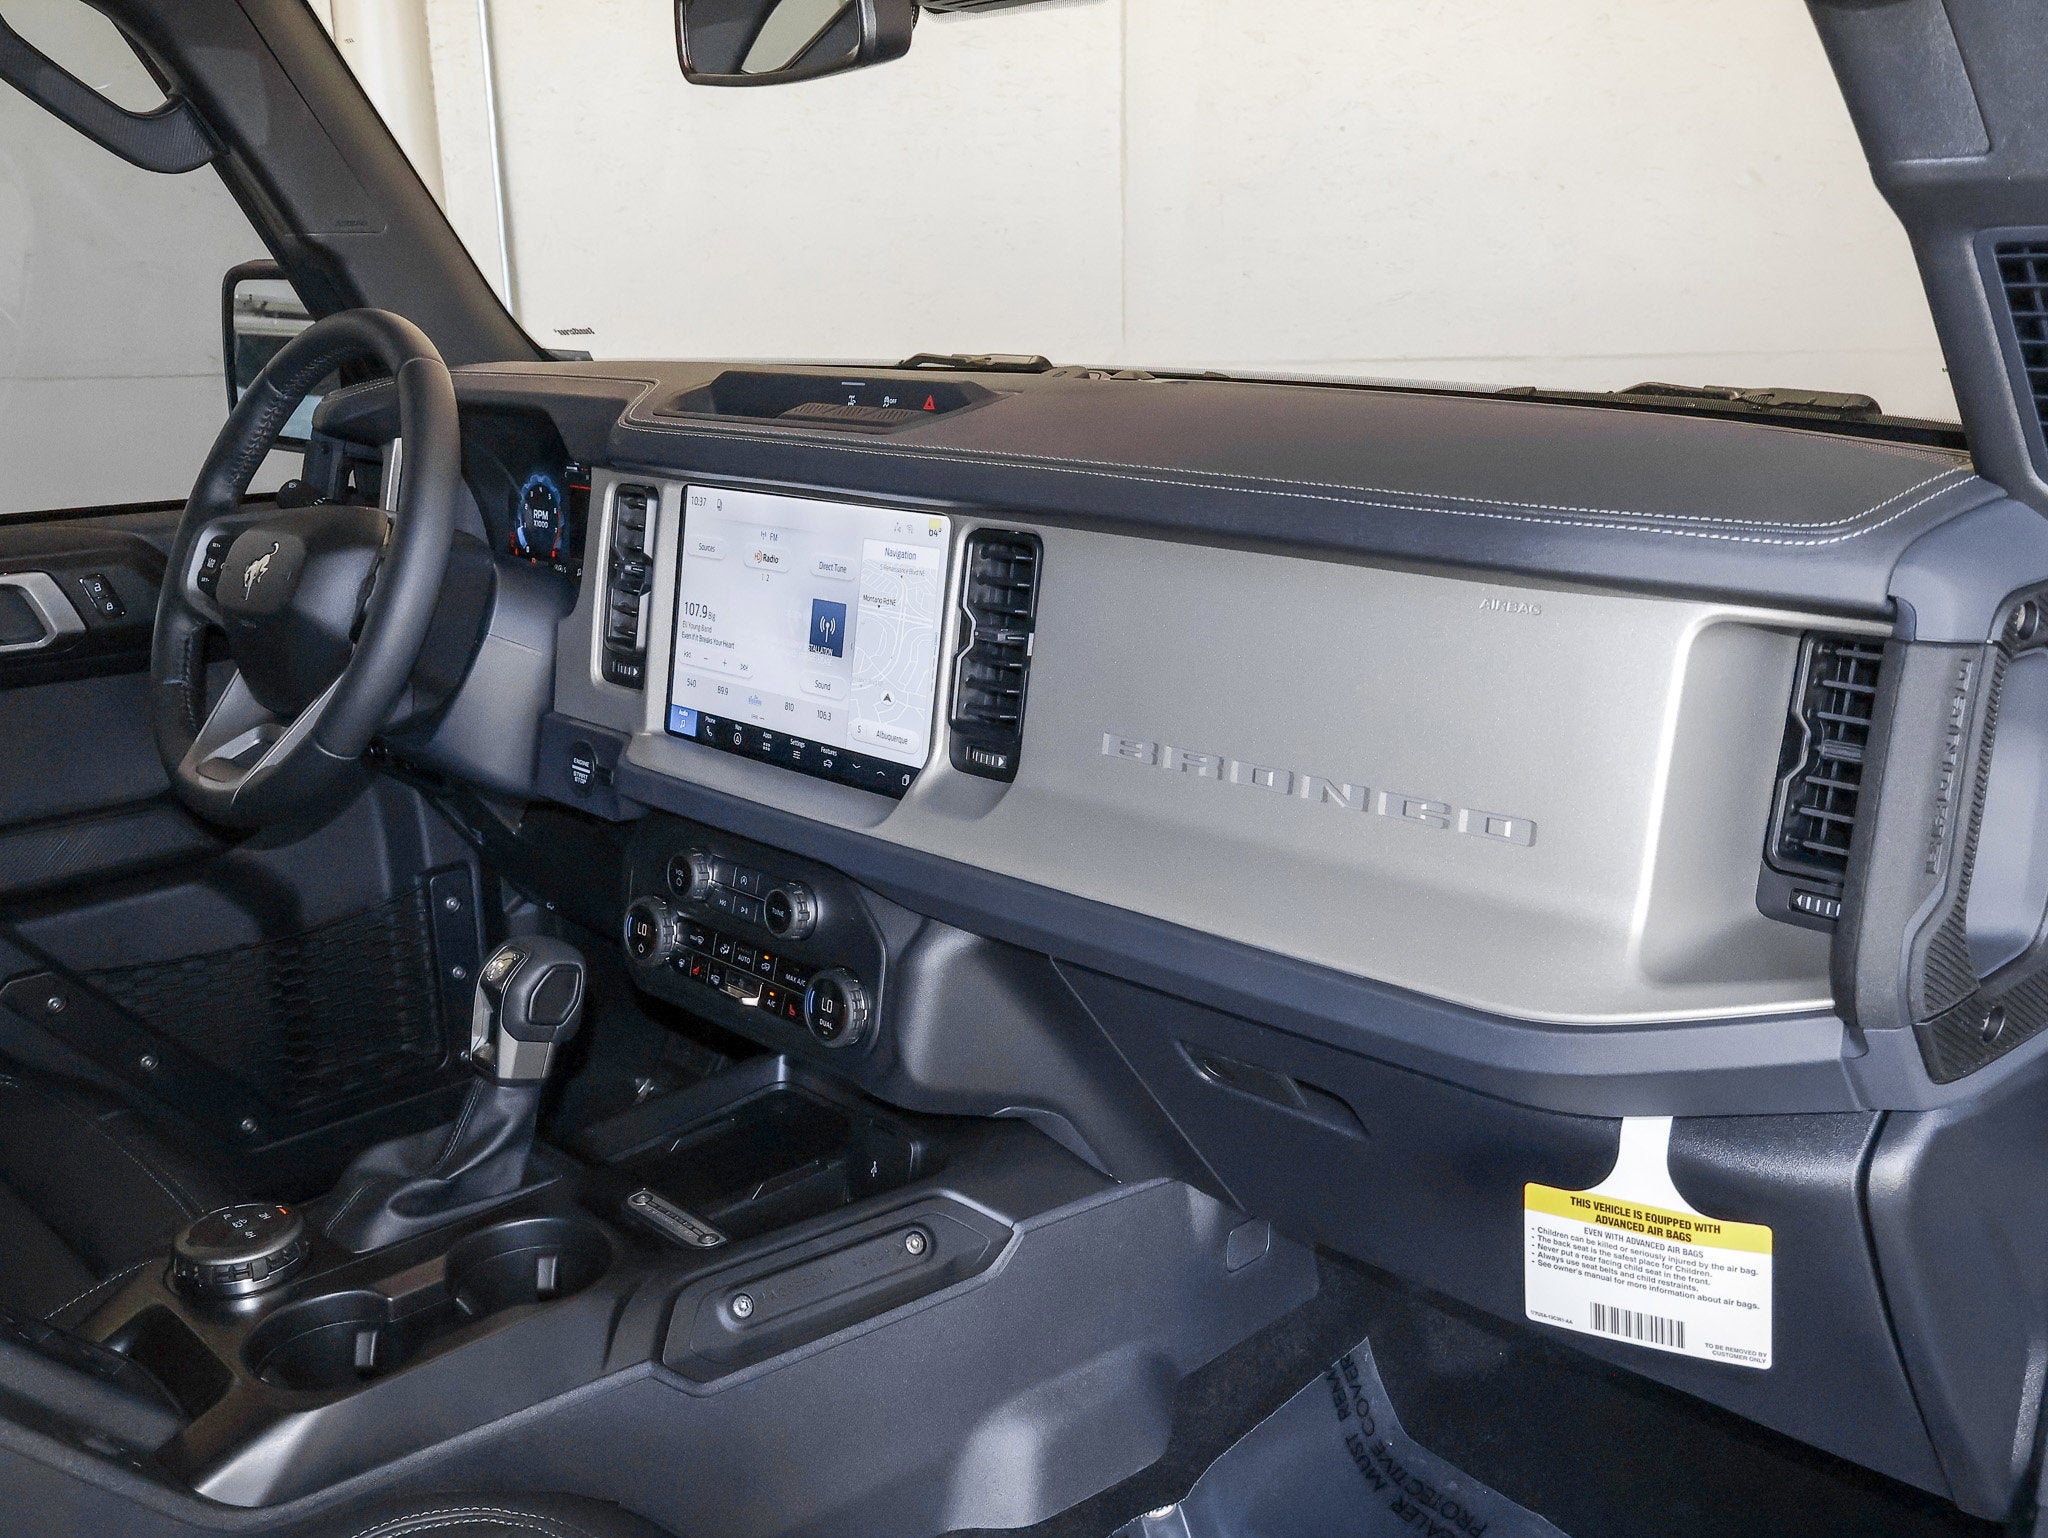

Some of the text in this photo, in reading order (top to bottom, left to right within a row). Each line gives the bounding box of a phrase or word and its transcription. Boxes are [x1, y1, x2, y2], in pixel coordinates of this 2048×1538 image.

[691, 496, 706, 506] 10:37
[533, 509, 548, 520] RPM
[770, 532, 778, 541] FM
[698, 543, 716, 552] Sources
[763, 554, 779, 563] Radio
[885, 547, 917, 560] Navigation
[819, 562, 847, 573] Direct Tune
[685, 602, 708, 618] 107.9
[1479, 599, 1541, 615] AIRBAG
[689, 622, 700, 632] Young
[701, 624, 712, 633] Band
[723, 640, 735, 649] Heart
[687, 678, 696, 687] 540
[815, 680, 831, 691] Sound
[784, 702, 794, 712] 810
[678, 709, 688, 717] Audio
[817, 710, 832, 721] 106.3
[705, 716, 716, 724] Phone
[763, 732, 772, 740] Apps
[876, 730, 908, 744] Albuquerque
[790, 739, 806, 749] Settings
[821, 746, 837, 756] Features
[574, 758, 590, 767] ENGINE
[574, 770, 588, 779] START
[1102, 732, 1537, 847] BRONCO
[638, 922, 647, 936] LO
[738, 955, 750, 964] AUTO
[785, 973, 806, 987] MAX A/C
[821, 997, 833, 1014] LO
[820, 1018, 833, 1030] DUAL
[1570, 1196, 1721, 1234] THIS VEHICLE IS EQUIPPED WITH
[1595, 1215, 1692, 1242] ADVANCED AIR BAGS
[1584, 1227, 1704, 1258] EVEN WITH ADVANCED AIR BAGS
[1537, 1226, 1569, 1238] Children
[1586, 1238, 1596, 1246] be
[1597, 1240, 1618, 1250] killed
[1630, 1248, 1666, 1261] seriously
[1668, 1254, 1696, 1267] injured
[1698, 1260, 1708, 1269] by
[1711, 1263, 1724, 1271] the
[1740, 1267, 1758, 1276] bag.
[1538, 1235, 1551, 1244] The
[1553, 1238, 1570, 1248] back
[1572, 1243, 1588, 1252] seat
[1591, 1246, 1597, 1254] is
[1599, 1248, 1612, 1257] the
[1613, 1251, 1637, 1262] safest
[1638, 1256, 1659, 1267] place
[1675, 1266, 1712, 1277] Children.
[1537, 1243, 1558, 1254] Never
[1561, 1248, 1573, 1257] put
[1582, 1254, 1596, 1263] rear
[1598, 1256, 1622, 1269] facing
[1624, 1261, 1643, 1272] child
[1645, 1267, 1662, 1277] seat
[1673, 1272, 1686, 1281] the
[1688, 1275, 1710, 1286] front.
[1538, 1251, 1699, 1292] Always use seat belts and child restraints.
[1538, 1260, 1551, 1268] See
[1554, 1264, 1583, 1276] owner's
[1584, 1270, 1612, 1283] manual
[1614, 1277, 1625, 1285] for
[1627, 1280, 1647, 1290] more
[1649, 1285, 1695, 1300] information
[1697, 1295, 1721, 1304] about
[1736, 1300, 1760, 1310] bags.
[1712, 1350, 1748, 1360] CUSTOMER
[1725, 1346, 1756, 1356] REMOVED
[1341, 1354, 1488, 1538] PROTECTIVE COVER
[1345, 1433, 1388, 1492] MUST
